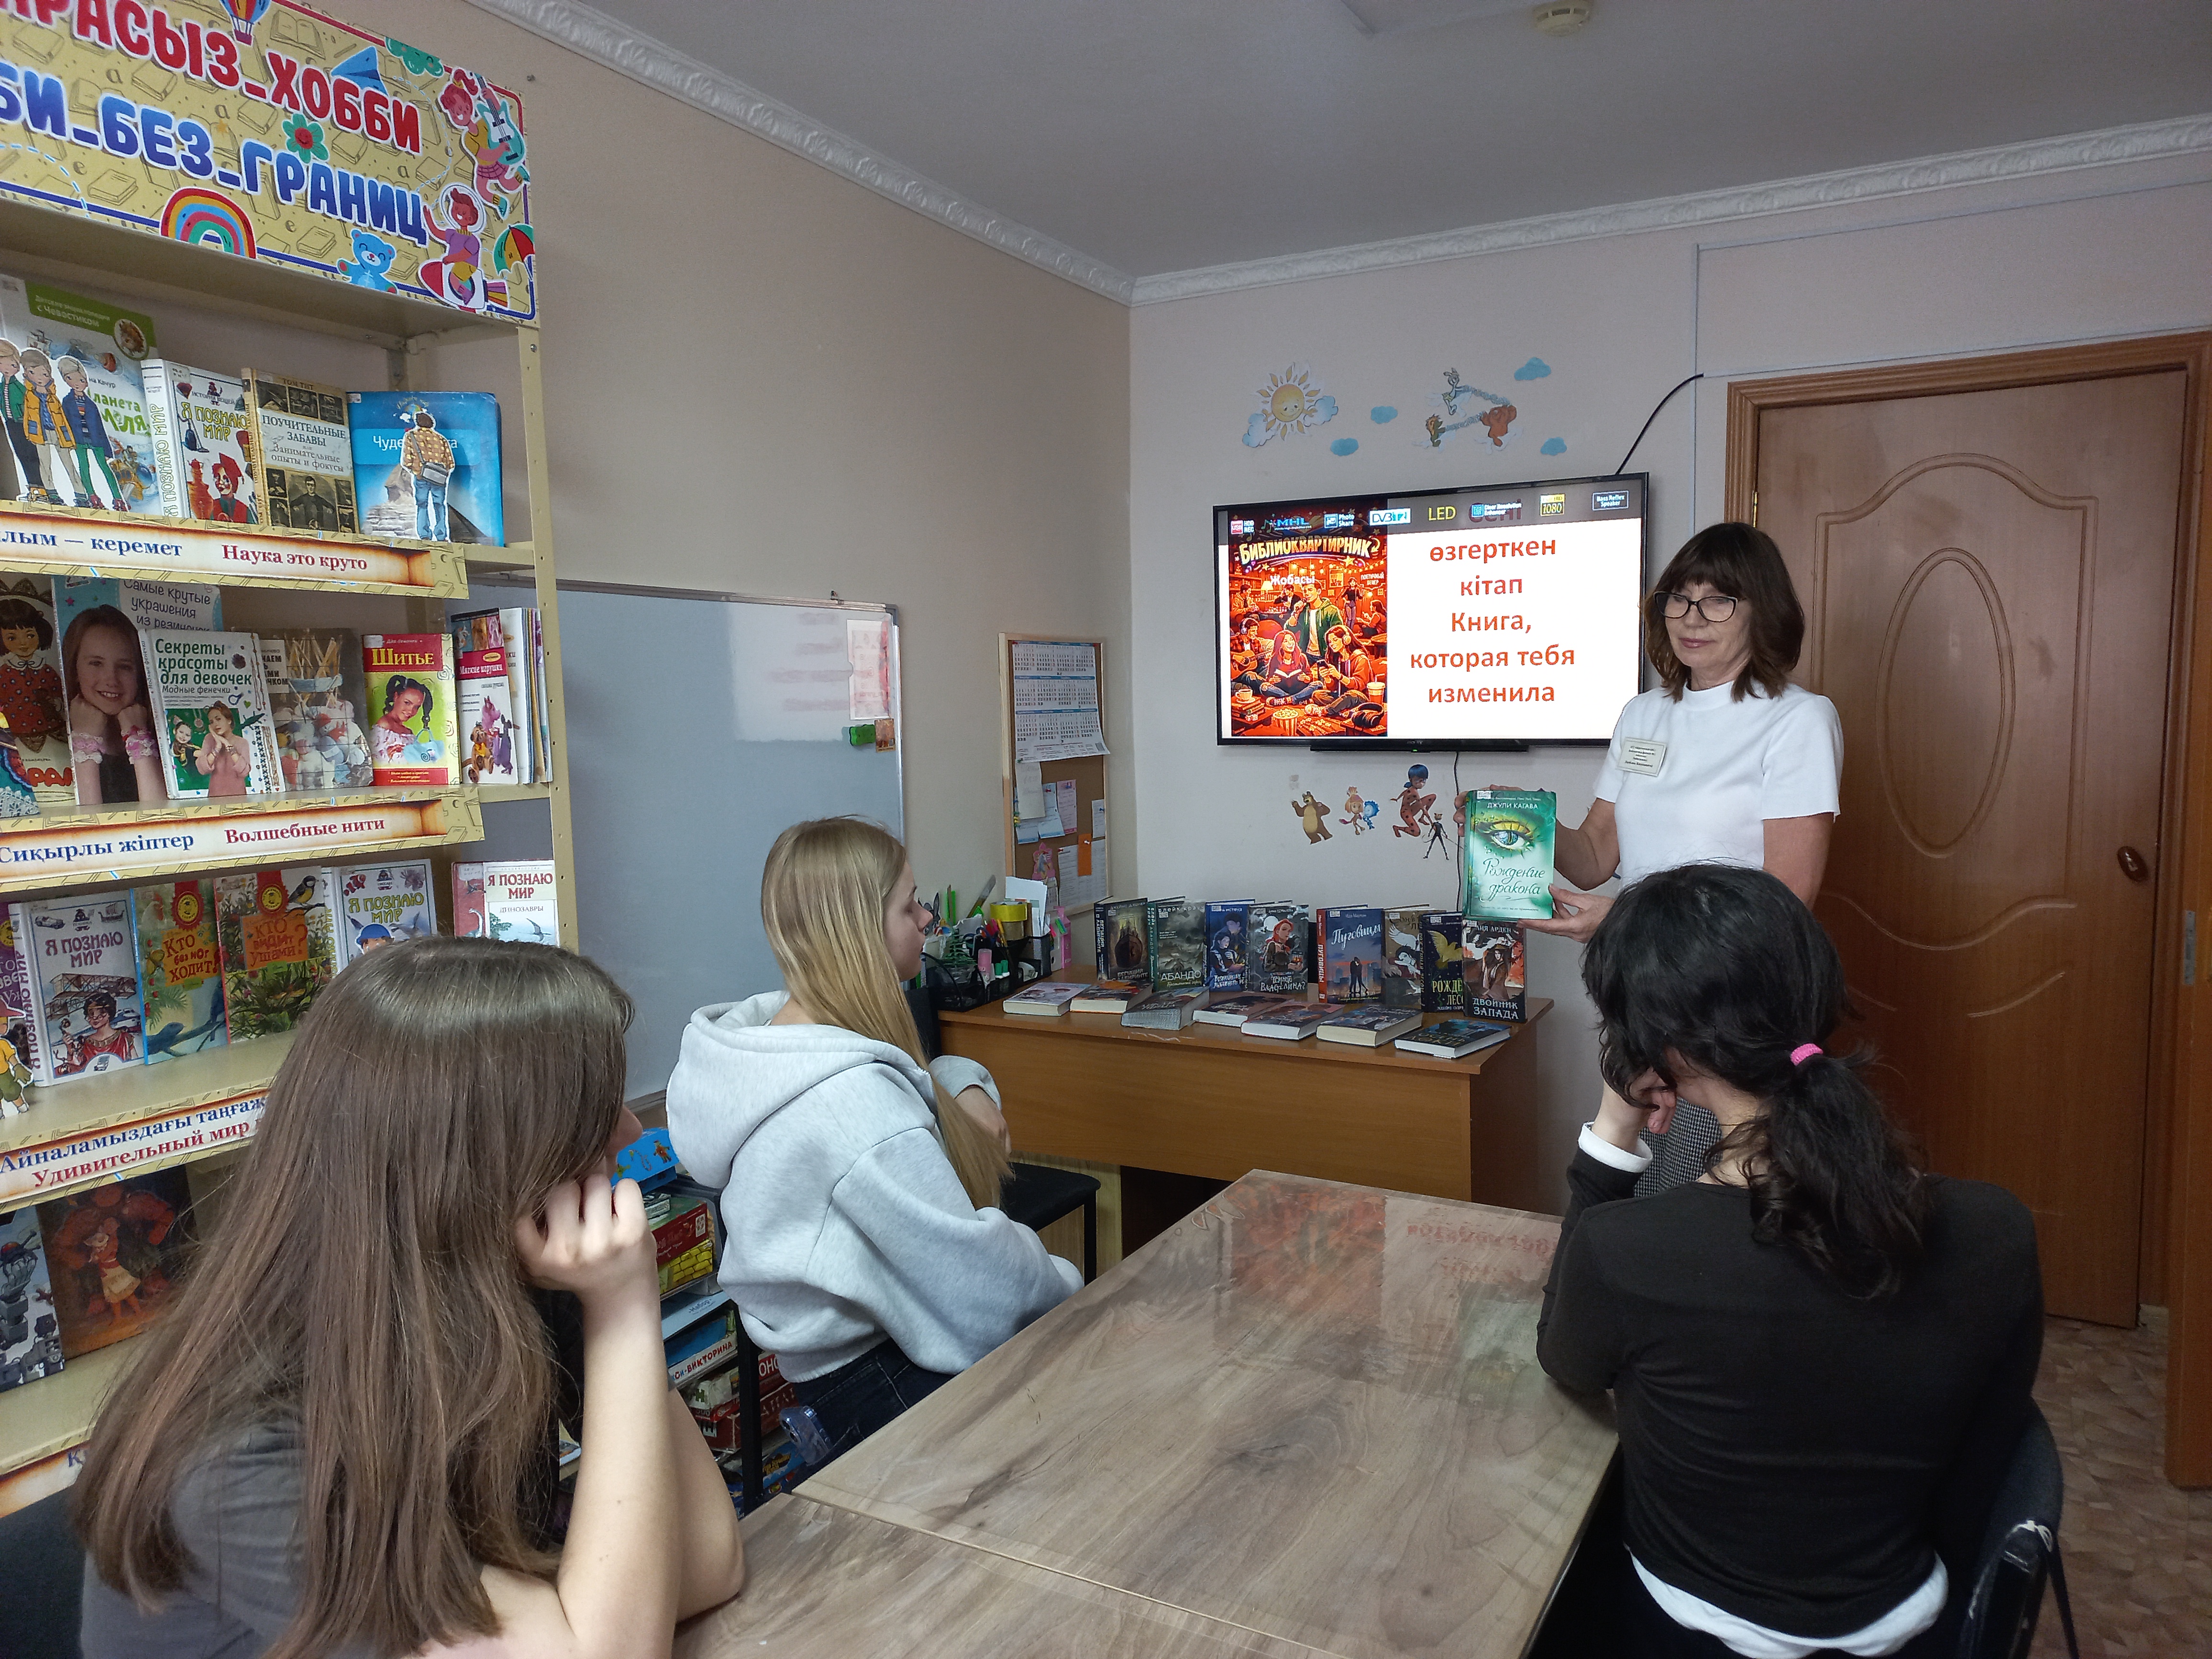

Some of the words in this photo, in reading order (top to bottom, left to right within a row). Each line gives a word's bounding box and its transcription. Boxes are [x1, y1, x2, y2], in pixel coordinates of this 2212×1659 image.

[150, 403, 167, 436] МИР
[181, 401, 193, 419] Я
[194, 406, 248, 430] ПОЗНАЮ
[203, 424, 231, 442] МИР
[262, 414, 346, 439] ПОУЧИТЕЛЬНЫЕ
[287, 431, 327, 447] ЗАБАВЫ
[273, 443, 340, 463] Занимательные
[271, 454, 300, 465] опыты
[312, 459, 344, 472] фокусы
[1428, 505, 1457, 521] LED
[1543, 503, 1562, 514] 1080
[1276, 517, 1310, 527] MHL
[0, 530, 57, 547] лым
[91, 536, 182, 557] керемет
[1239, 535, 1373, 564] БИБЛИОКВАРТИРНИК
[1430, 540, 1556, 564] өзгерткен
[221, 543, 283, 565] Наука
[287, 552, 316, 566] это
[319, 555, 367, 573] круто
[1270, 574, 1315, 586] Жобасы
[1460, 575, 1523, 596] кітап
[167, 587, 211, 605] крутые
[131, 596, 196, 619] украшения
[136, 615, 152, 626] из
[1451, 612, 1531, 634] Книга,
[155, 639, 225, 658] Секреты
[1411, 651, 1508, 672] которая
[1517, 643, 1575, 666] тебя
[158, 656, 228, 673] красоты
[160, 669, 191, 685] для
[193, 670, 252, 685] девочек
[162, 685, 196, 695] Модные
[197, 686, 231, 696] фенечки
[1428, 686, 1555, 703] изменила
[224, 823, 338, 844] Волшебные
[341, 819, 385, 833] нити
[0, 842, 113, 863] Сиқырлы
[119, 834, 195, 853] жіптер
[487, 875, 497, 886] Я
[498, 873, 553, 886] ПОЗНАЮ
[1482, 858, 1546, 885] Рождение
[508, 887, 534, 899] МИР
[1488, 881, 1541, 901] дракона
[348, 898, 361, 914] Я
[363, 892, 424, 911] ПОЗНАЮ
[499, 905, 544, 913] ДИНОЗАВРЫ
[371, 907, 403, 924] МИР
[45, 938, 58, 956] Я
[61, 930, 124, 955] ПОЗНАЮ
[1331, 924, 1382, 951] Пуговицы
[70, 949, 103, 968] МИР
[1161, 970, 1202, 982] АБАНДО
[1432, 979, 1463, 995] РОЖДЕ
[1472, 997, 1518, 1009] ДВОЙНИК
[1473, 1007, 1519, 1019] ЗАПАДА
[0, 1116, 191, 1174] Айналамыздағы
[32, 1128, 204, 1188] Удивительный
[209, 1120, 250, 1143] мир
